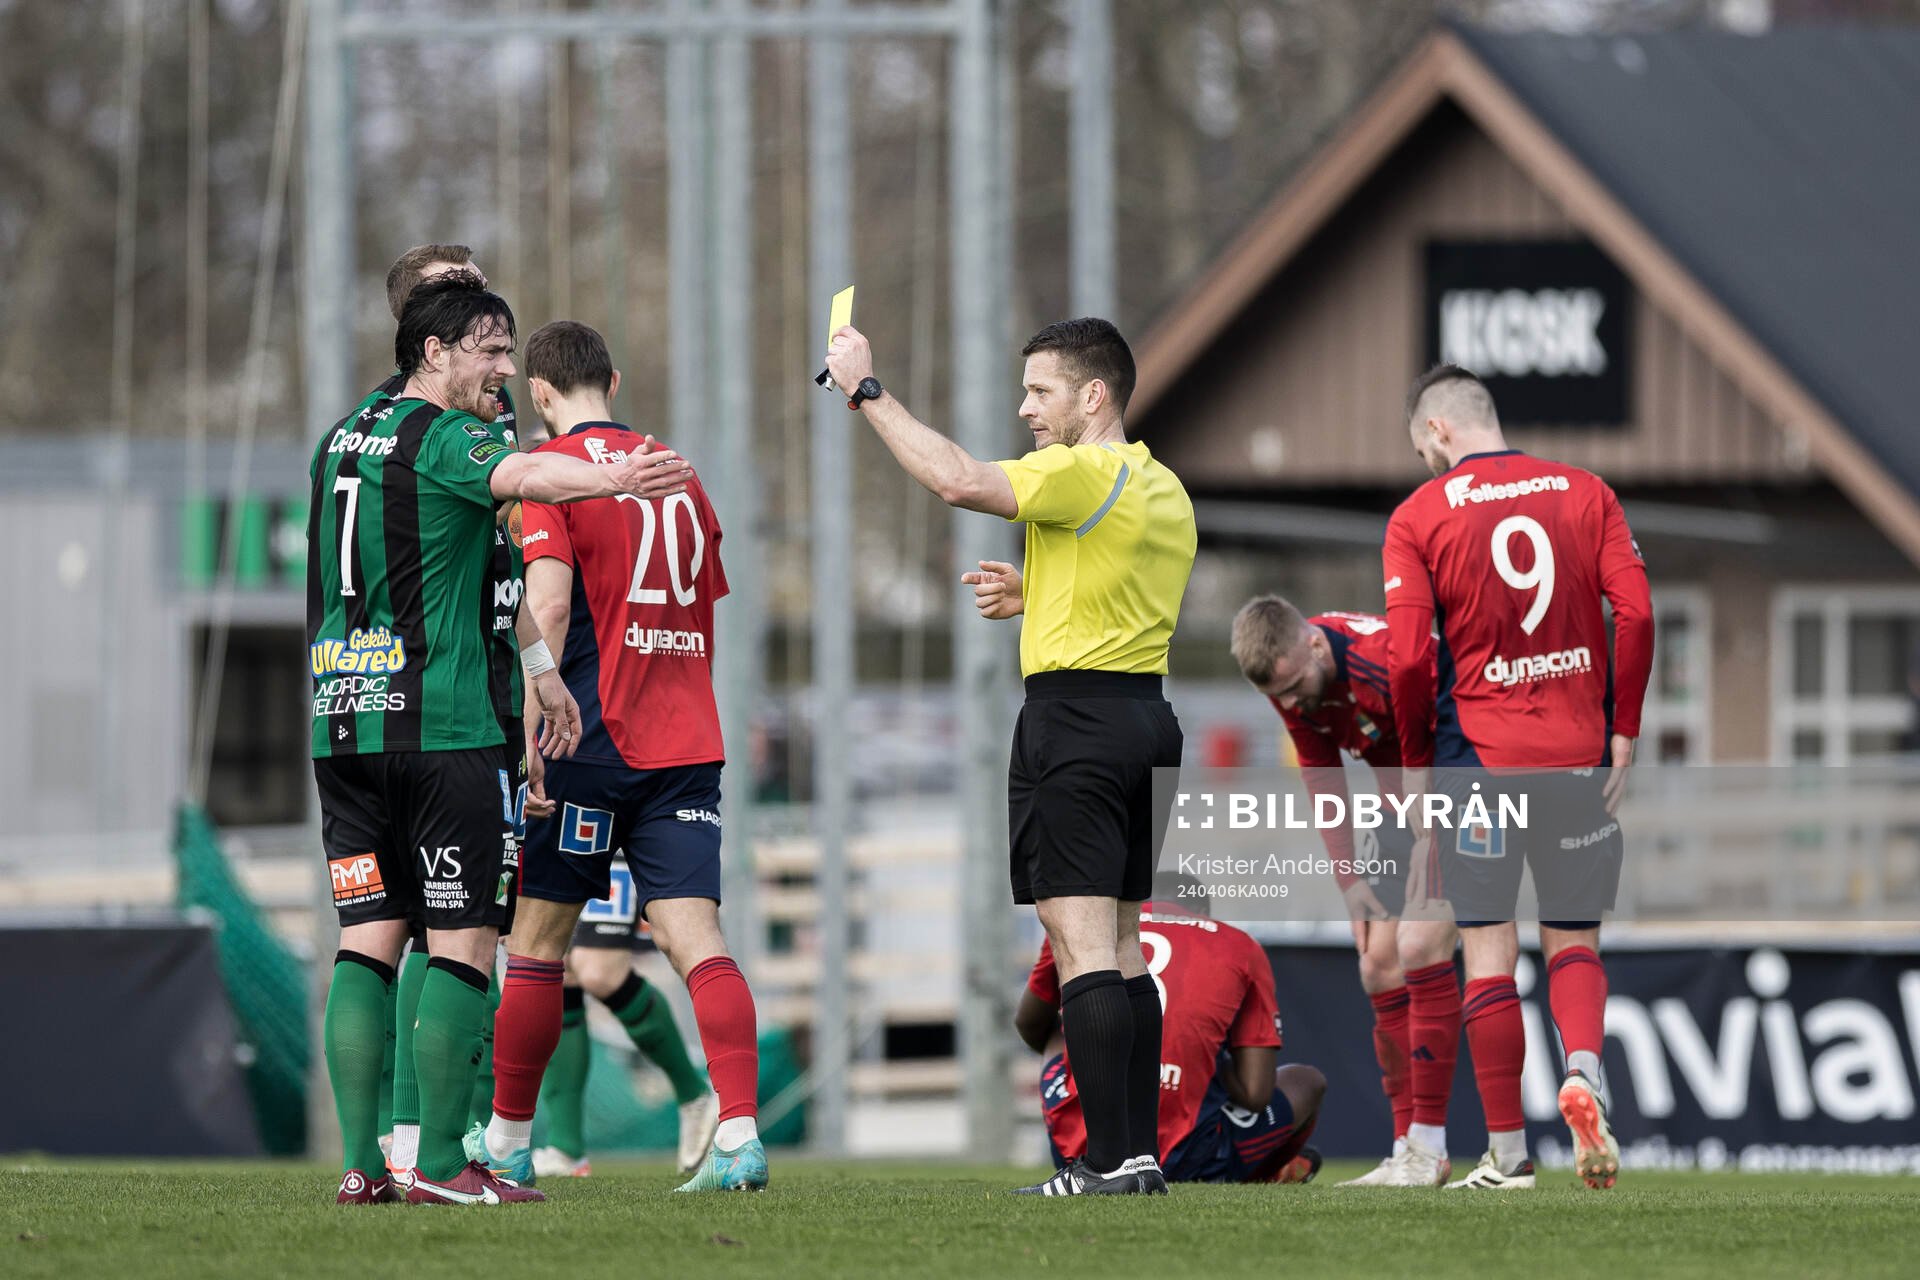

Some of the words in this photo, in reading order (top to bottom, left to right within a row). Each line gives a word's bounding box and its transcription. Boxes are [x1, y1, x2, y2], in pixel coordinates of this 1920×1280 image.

[1459, 475, 1570, 507] Fellessons
[522, 528, 549, 547] ravida
[613, 491, 705, 607] 20
[1490, 514, 1556, 637] 9
[349, 626, 392, 652] Gekås
[624, 621, 705, 655] dynacon
[311, 638, 405, 676] Ullared
[1483, 646, 1592, 687] dynacon
[315, 675, 387, 698] NORDIC
[312, 692, 406, 718] ELLNESS
[1559, 822, 1618, 850] SHARP
[330, 857, 376, 889] FMP
[420, 846, 462, 878] VS
[431, 899, 448, 909] ASIA
[448, 899, 465, 909] SPA
